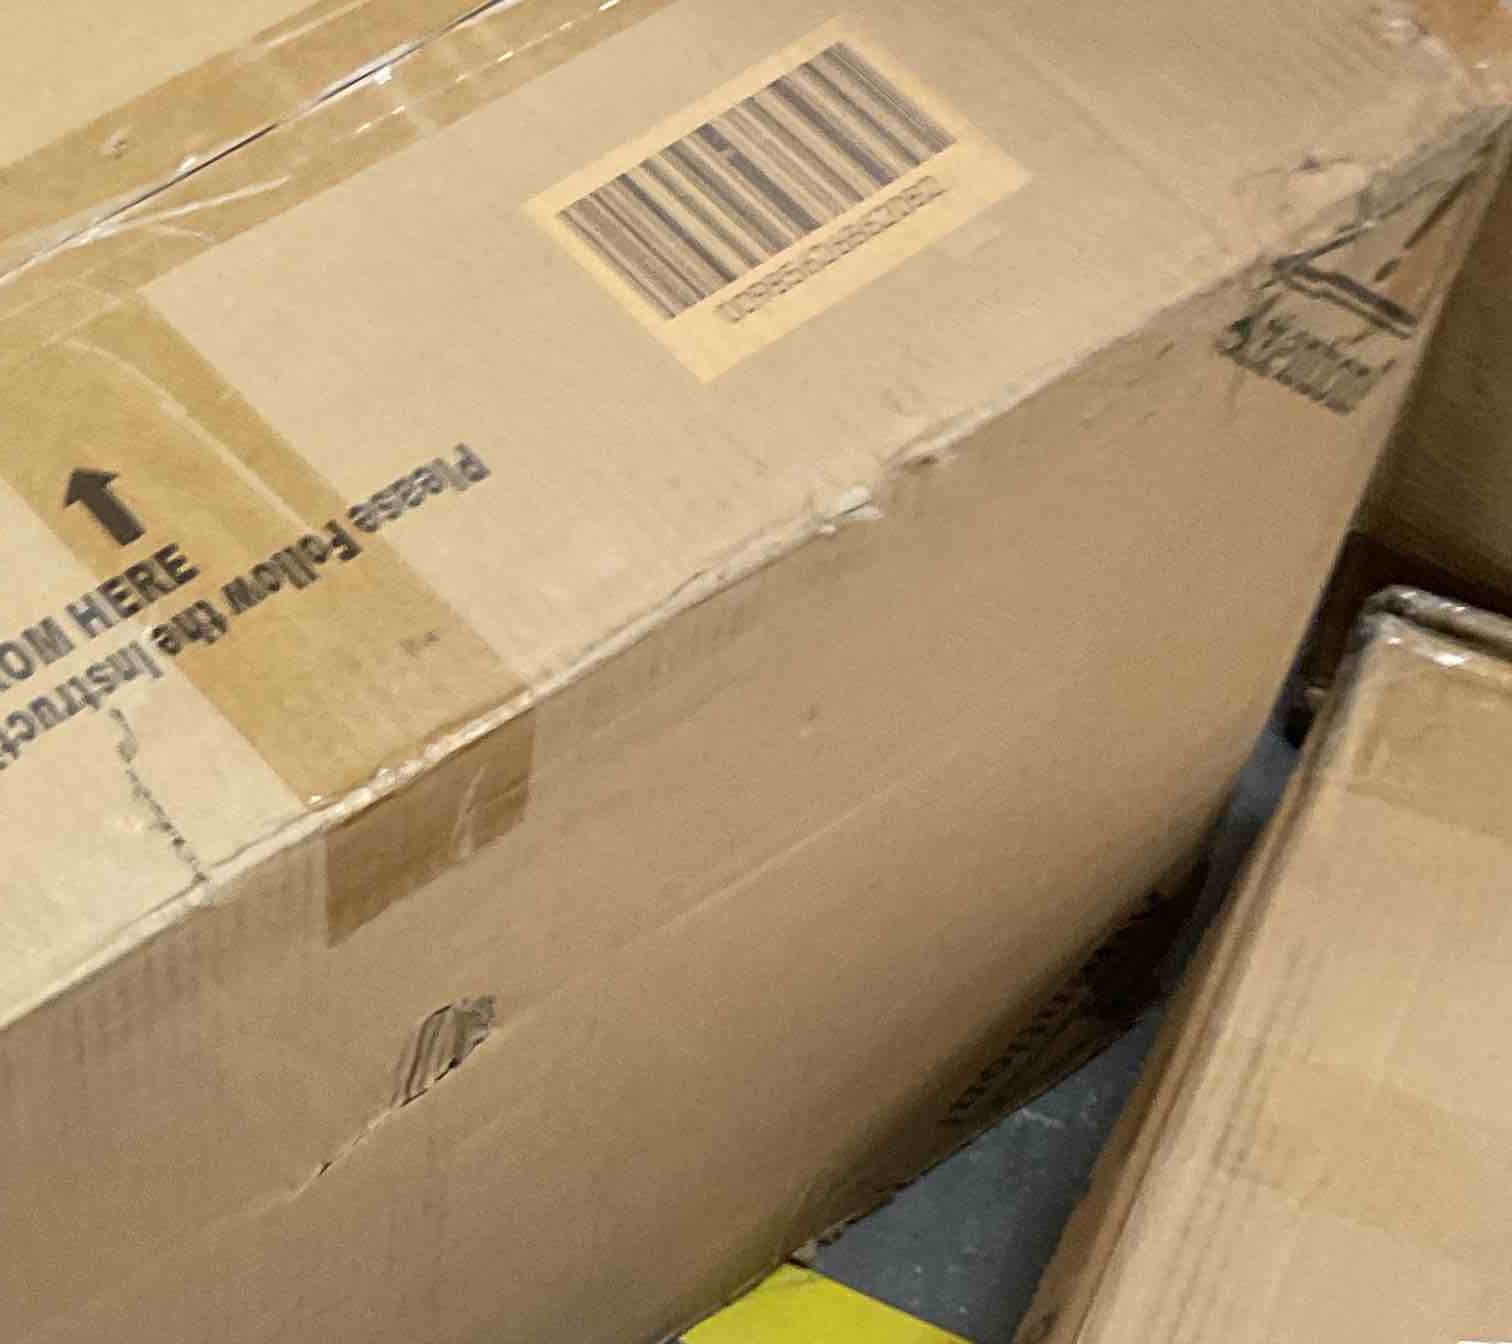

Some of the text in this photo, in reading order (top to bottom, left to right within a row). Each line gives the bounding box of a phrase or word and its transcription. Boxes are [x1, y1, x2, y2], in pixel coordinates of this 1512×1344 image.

[346, 442, 491, 533] Please
[65, 542, 200, 639] HERE
[221, 519, 363, 615] Follow
[151, 599, 230, 656] the
